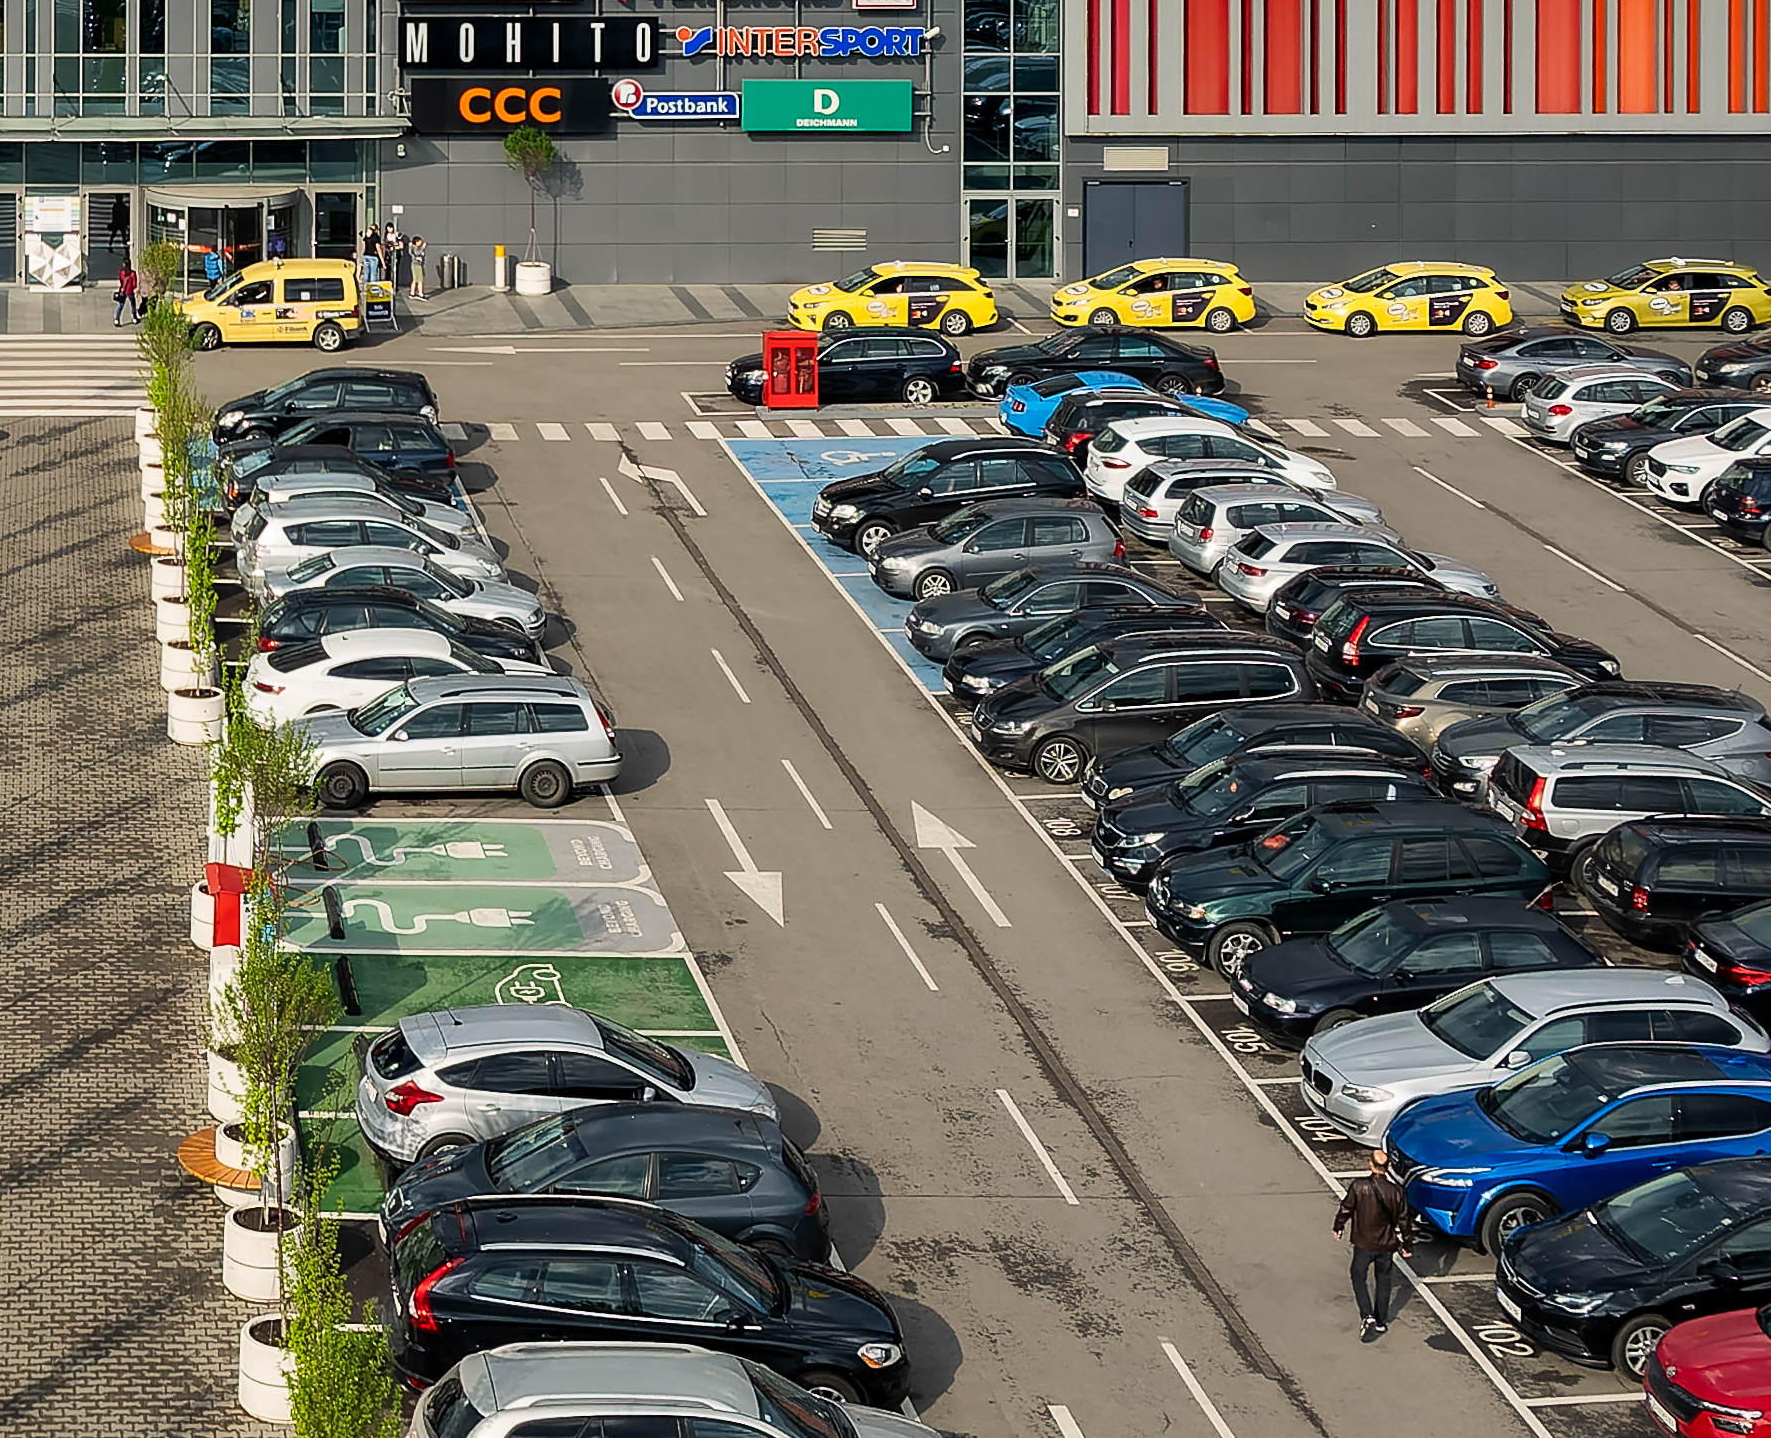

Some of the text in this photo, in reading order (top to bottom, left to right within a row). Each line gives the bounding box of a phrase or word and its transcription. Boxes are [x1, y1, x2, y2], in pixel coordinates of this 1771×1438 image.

[406, 22, 652, 64] MOHITO
[717, 25, 926, 58] INTERSPORT
[458, 87, 563, 125] CCC
[646, 97, 729, 115] Postbank
[813, 88, 841, 115] D
[796, 118, 858, 128] DEICHMANN
[1042, 817, 1082, 838] 108
[1154, 948, 1202, 973] 106
[1221, 1026, 1271, 1054] 105
[1294, 1115, 1347, 1142] 104
[1472, 1319, 1535, 1358] 102
